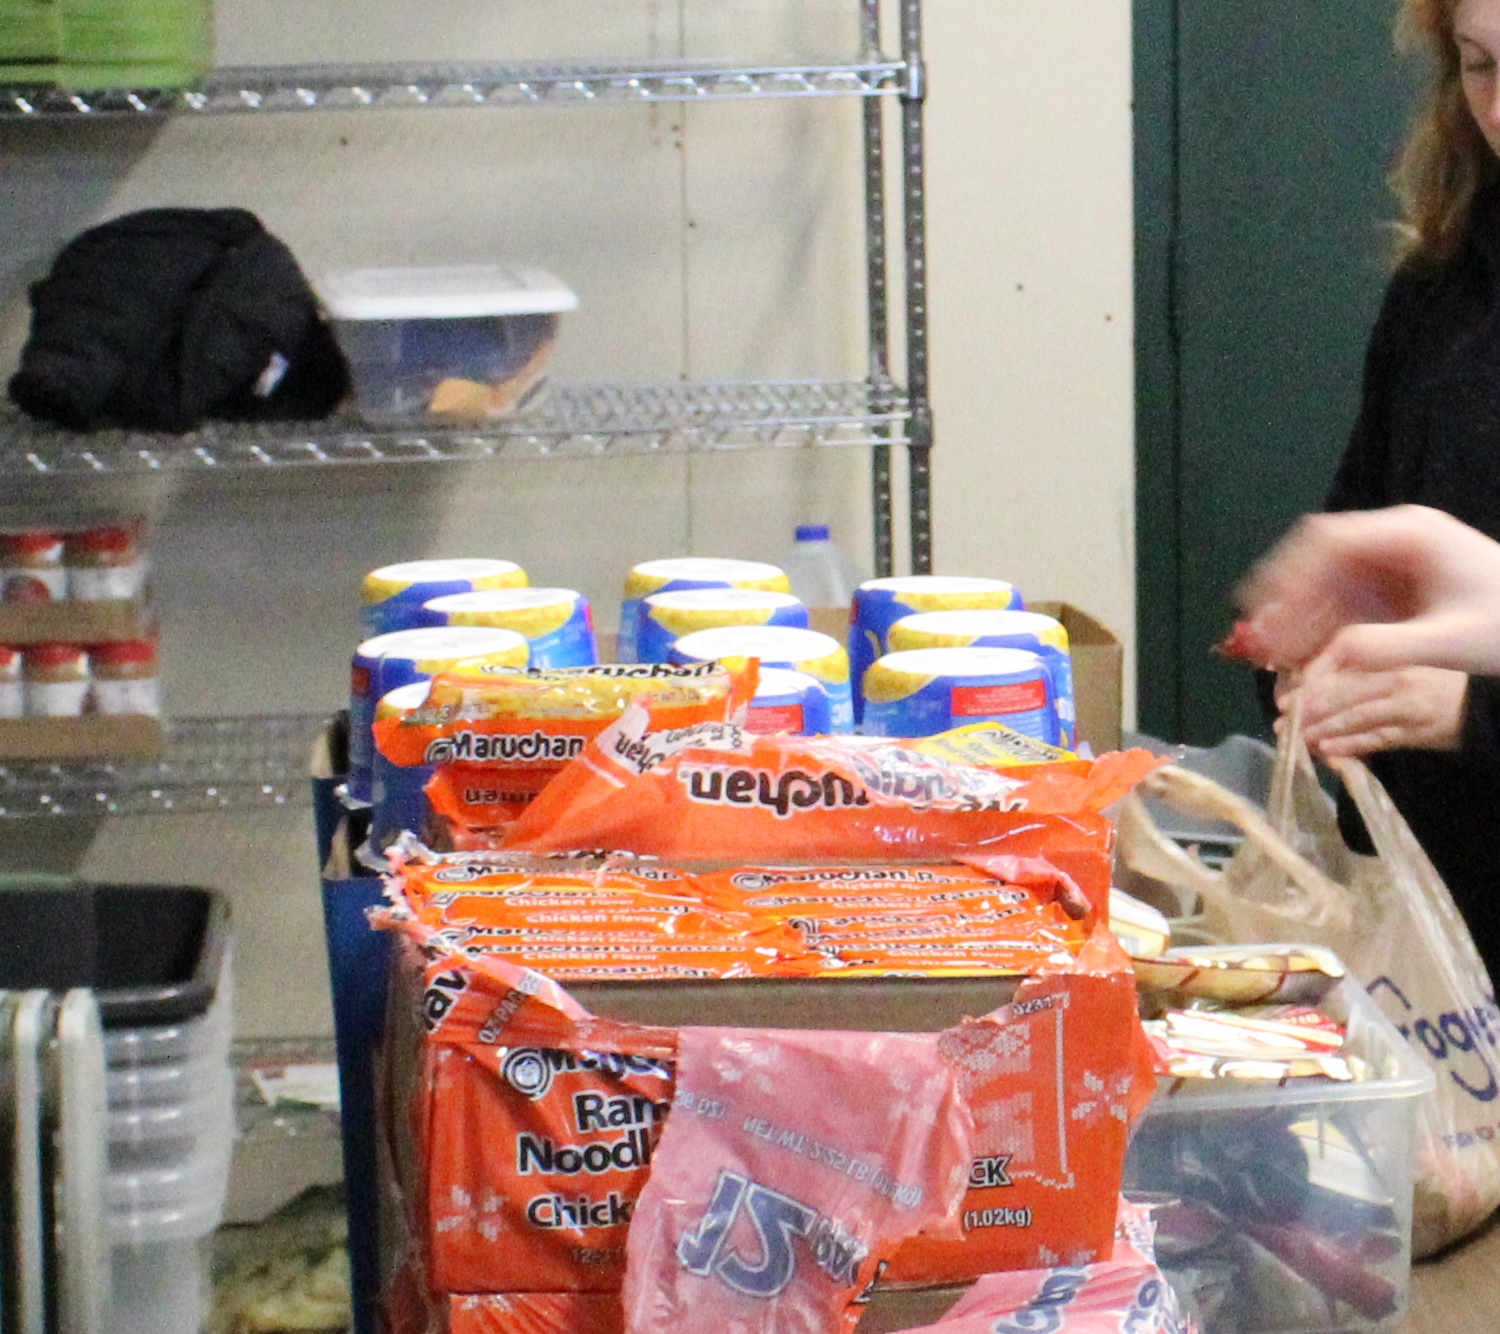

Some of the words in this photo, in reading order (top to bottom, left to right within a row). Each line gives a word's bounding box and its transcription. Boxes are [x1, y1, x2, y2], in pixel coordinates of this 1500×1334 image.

[453, 729, 586, 761] Maruchan
[505, 897, 587, 907] Chicken
[525, 913, 608, 924] Chicken
[611, 914, 658, 924] Flavor
[521, 934, 605, 944] Chicken
[522, 951, 606, 962] Chicken
[611, 952, 659, 962] Flavor
[963, 1204, 1033, 1230] (1.02kg)
